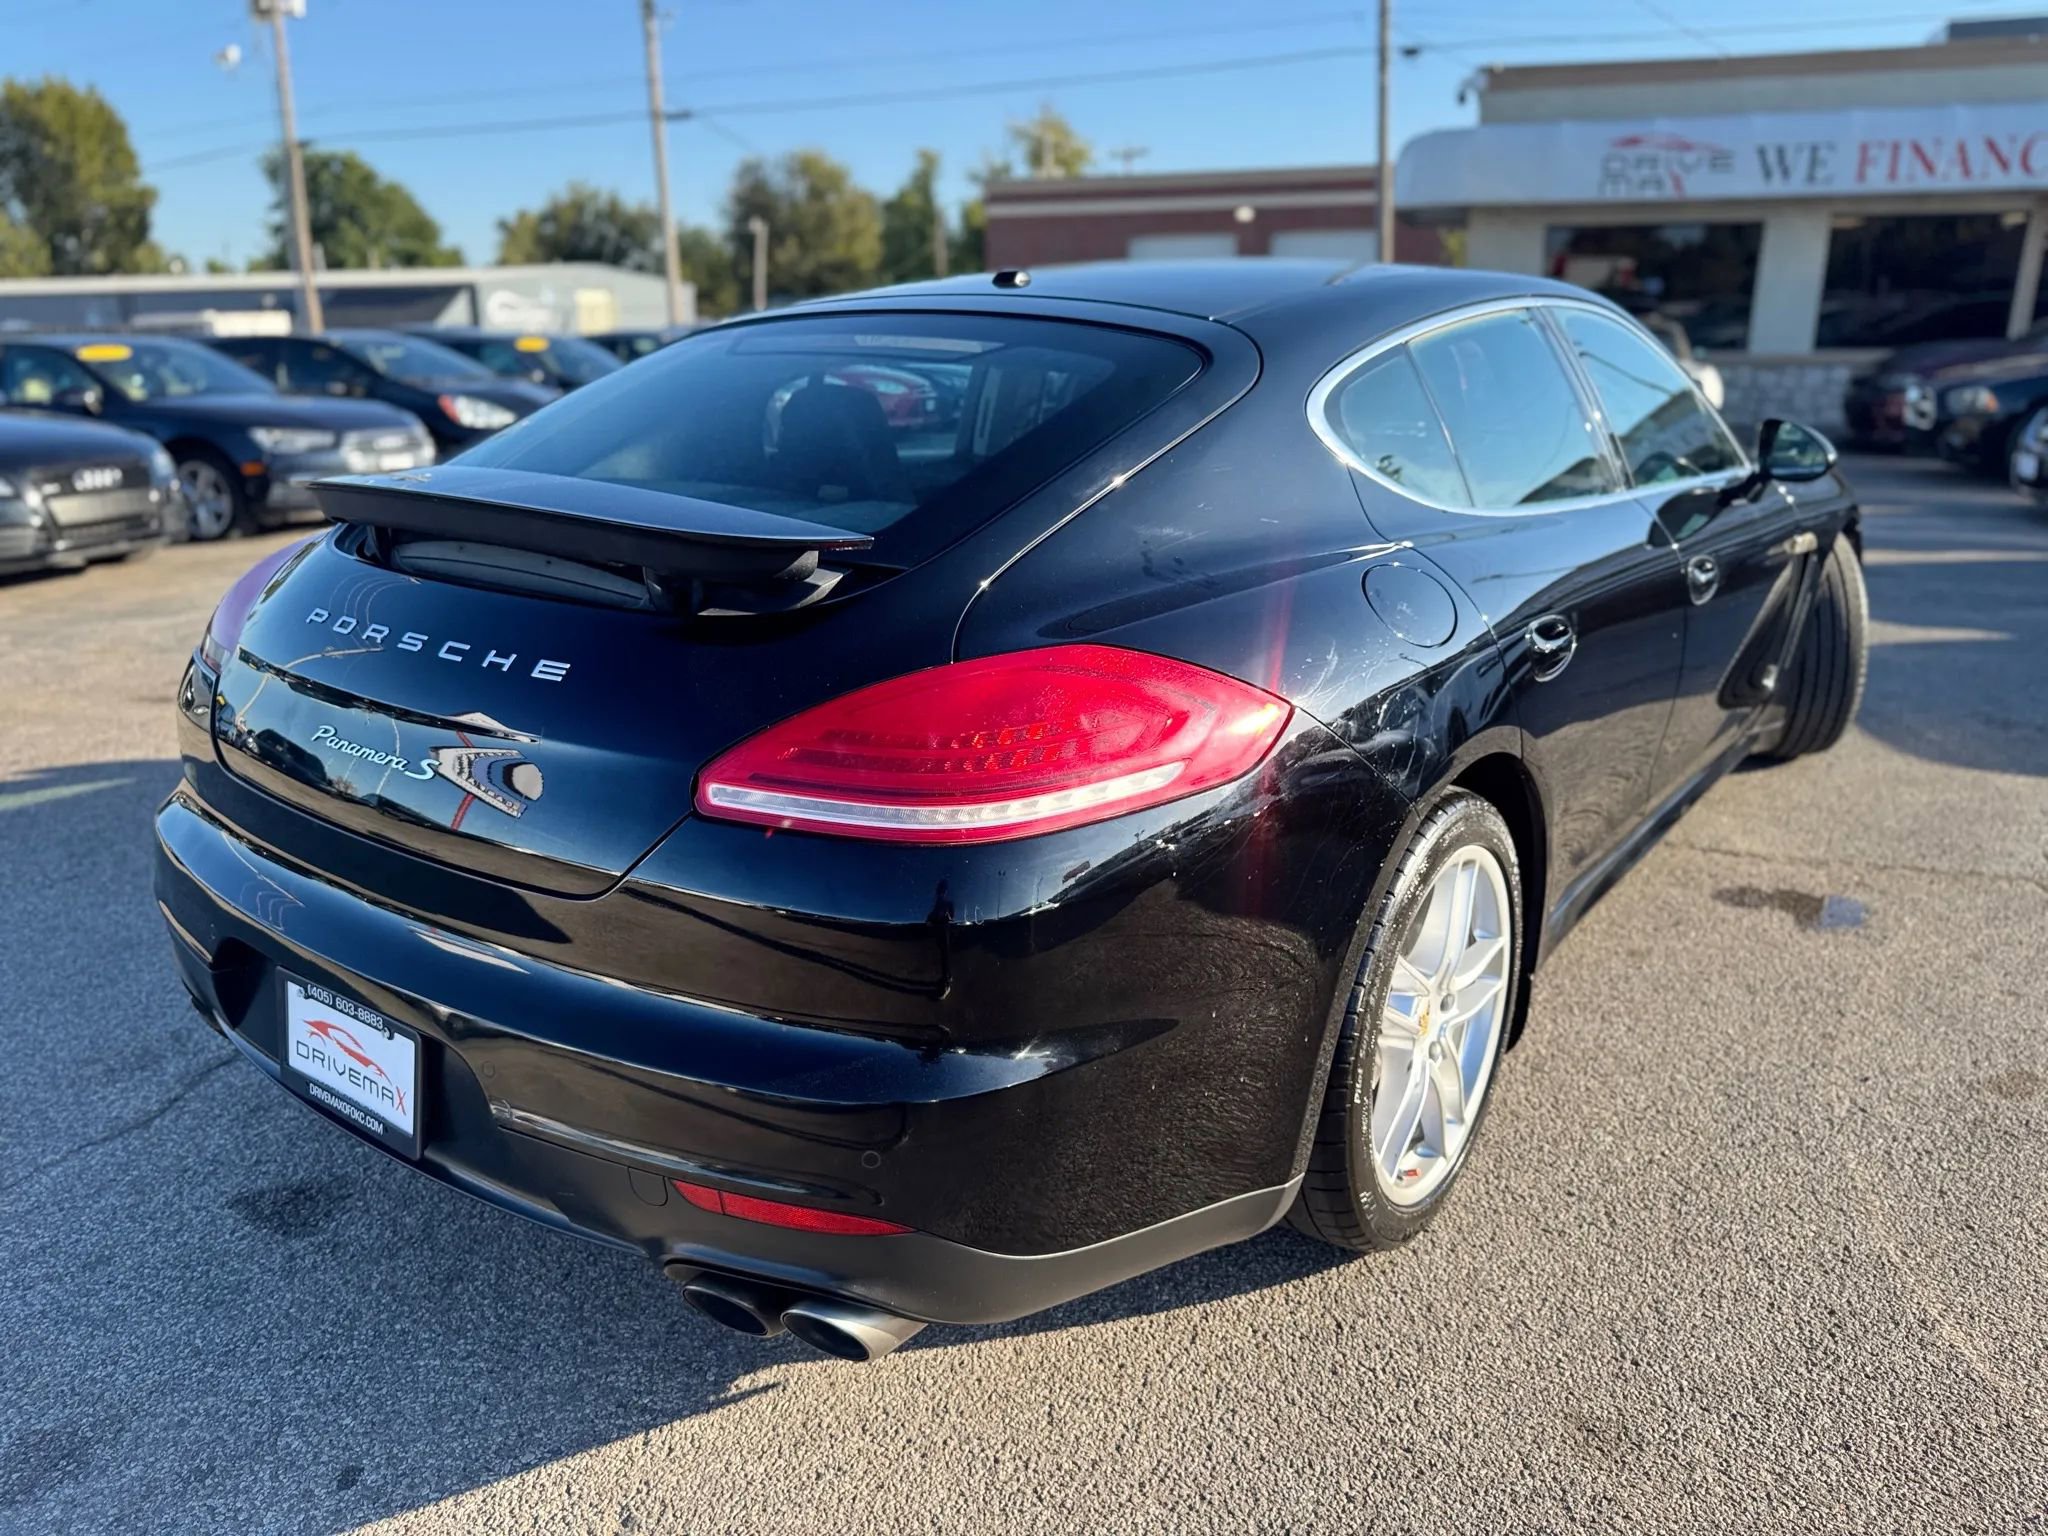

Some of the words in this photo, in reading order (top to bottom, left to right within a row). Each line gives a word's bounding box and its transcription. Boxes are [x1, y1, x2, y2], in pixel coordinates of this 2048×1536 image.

[1602, 152, 1736, 176] DRIVE
[1755, 140, 1837, 184] WE
[305, 607, 571, 682] PORSCHE
[311, 725, 409, 771] Panamera
[404, 758, 440, 780] S
[307, 984, 333, 1006] (405)
[335, 997, 384, 1030] 603-8883
[295, 1040, 407, 1116] DRIVEMAX
